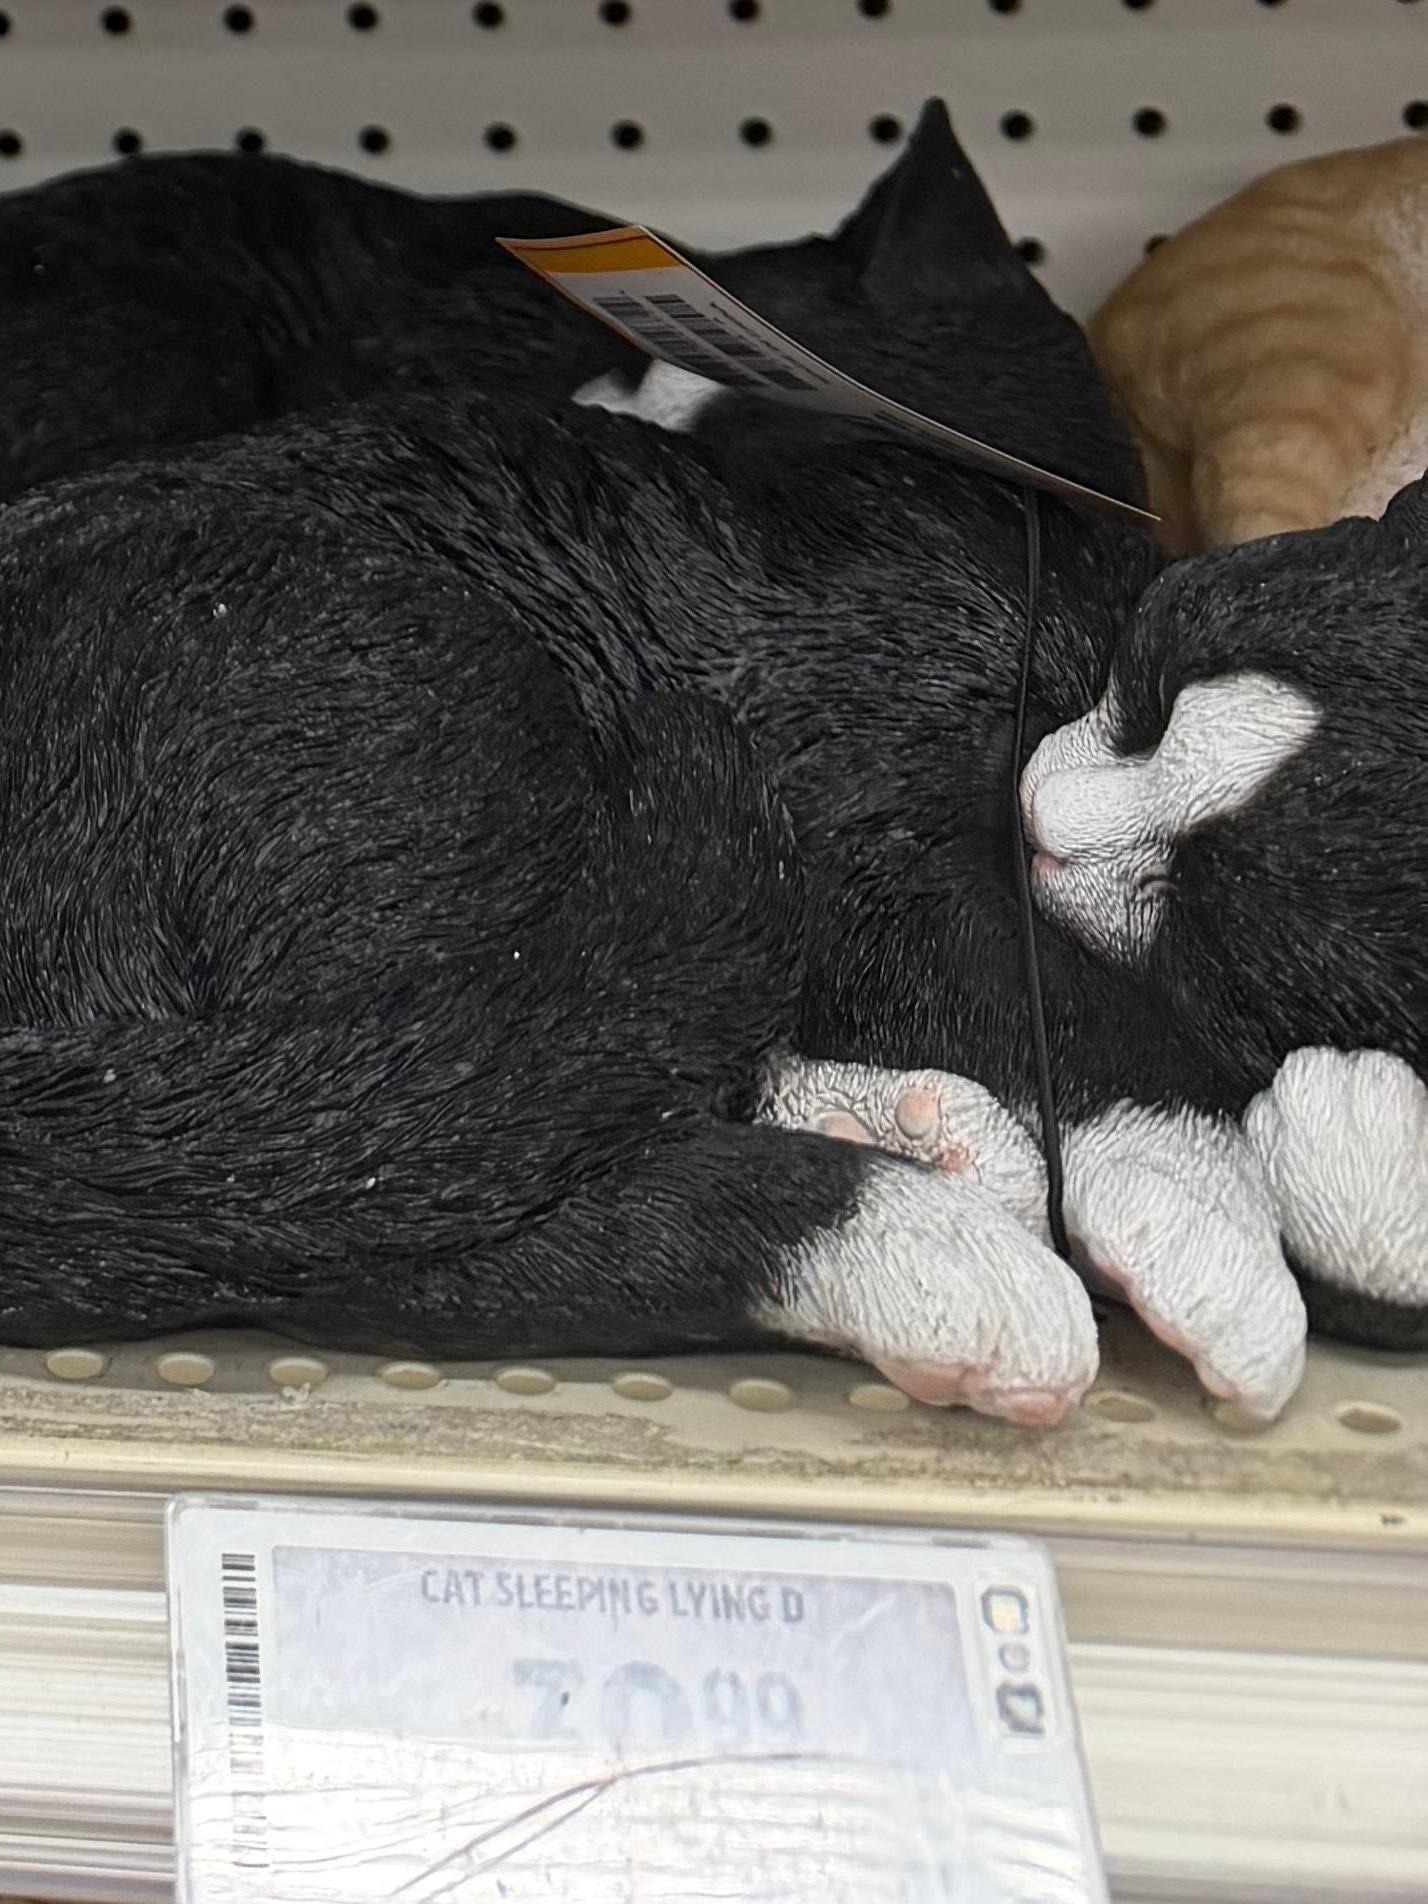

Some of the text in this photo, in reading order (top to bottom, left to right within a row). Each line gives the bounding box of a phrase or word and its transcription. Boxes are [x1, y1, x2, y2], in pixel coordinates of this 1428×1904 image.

[420, 1567, 485, 1607] CAT
[496, 1572, 660, 1617] SLEEPING
[670, 1580, 772, 1622] LYING
